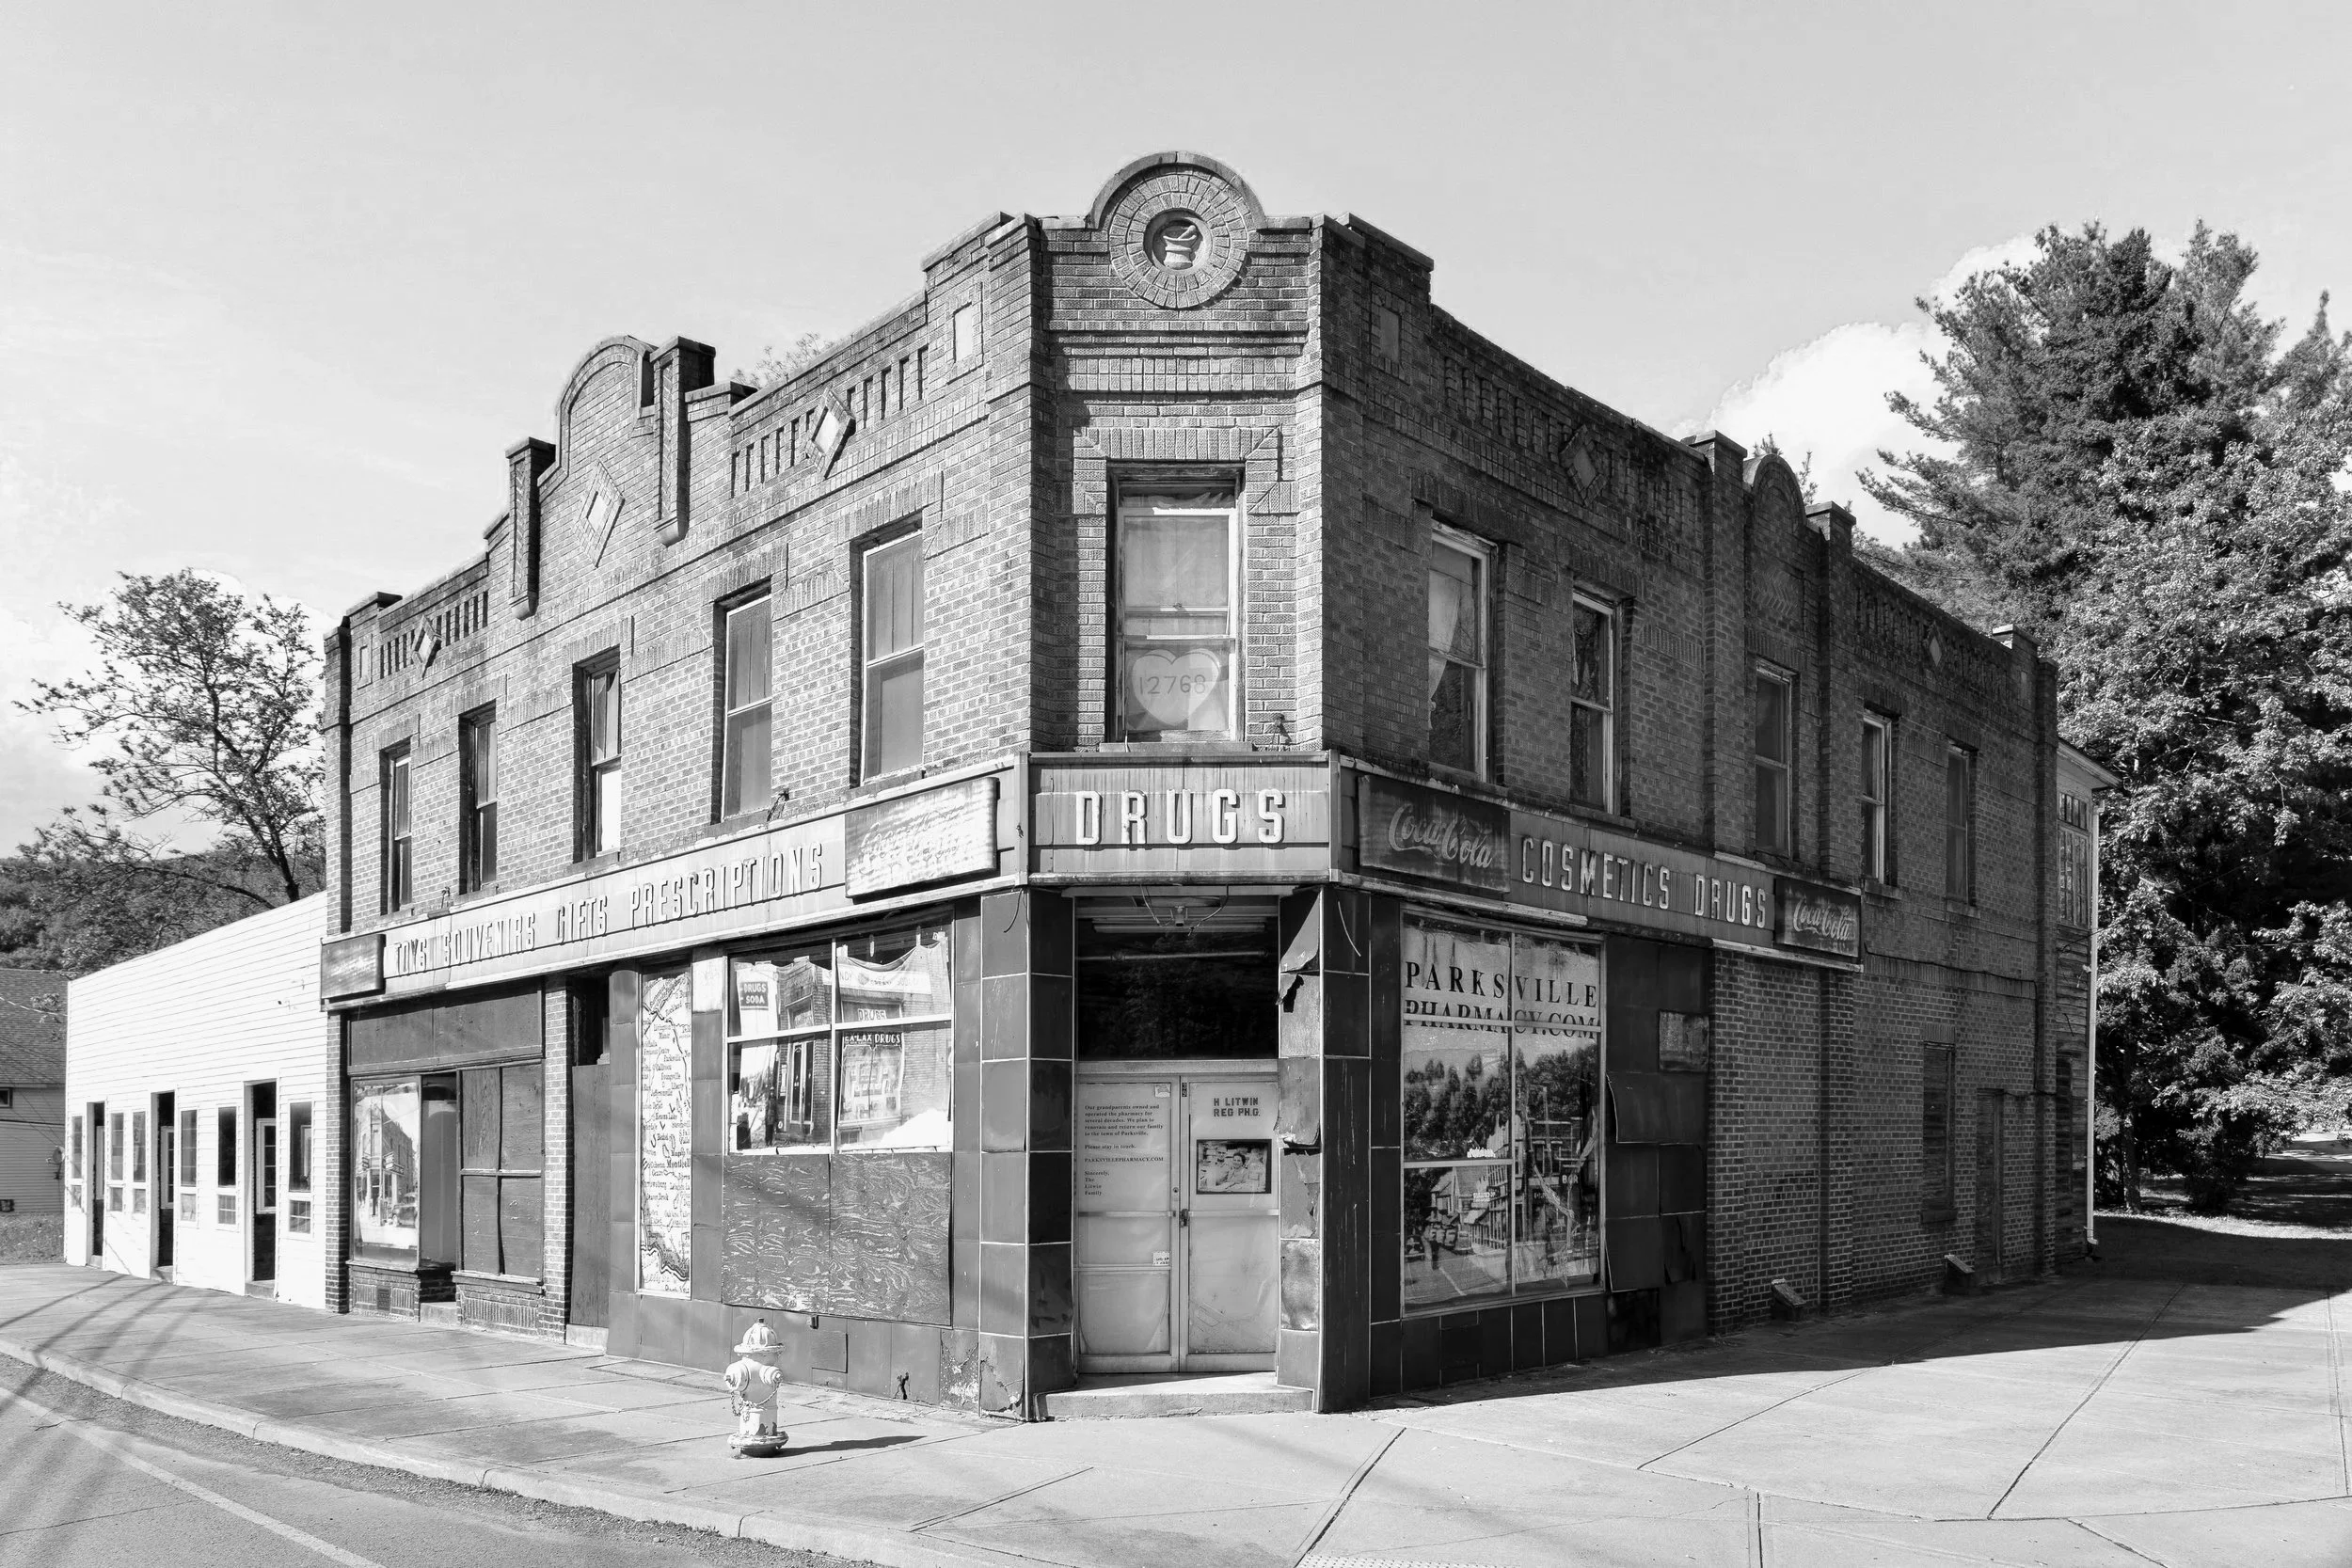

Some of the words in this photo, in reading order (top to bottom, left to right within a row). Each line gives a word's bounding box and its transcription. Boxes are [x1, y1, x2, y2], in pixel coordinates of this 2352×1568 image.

[1139, 674, 1206, 694] 12768
[1076, 787, 1285, 845] DRUGS
[1521, 836, 1671, 911] COSMETICS
[1693, 873, 1767, 929] DRUGS
[395, 939, 427, 976] TOYS
[444, 912, 535, 967] SOUVENIRS
[557, 895, 608, 945] GIFTS
[630, 842, 823, 929] PRESCRIPTIONS
[744, 983, 767, 993] DRUGS
[1405, 961, 1597, 1008] PARKSVILLE
[745, 994, 765, 1005] SODA
[1405, 1000, 1596, 1039] PHARMACY.COM
[875, 1034, 901, 1043] DRUGS
[1214, 1098, 1219, 1106] H
[1225, 1097, 1258, 1106] LITWIN
[1214, 1108, 1233, 1117] REG
